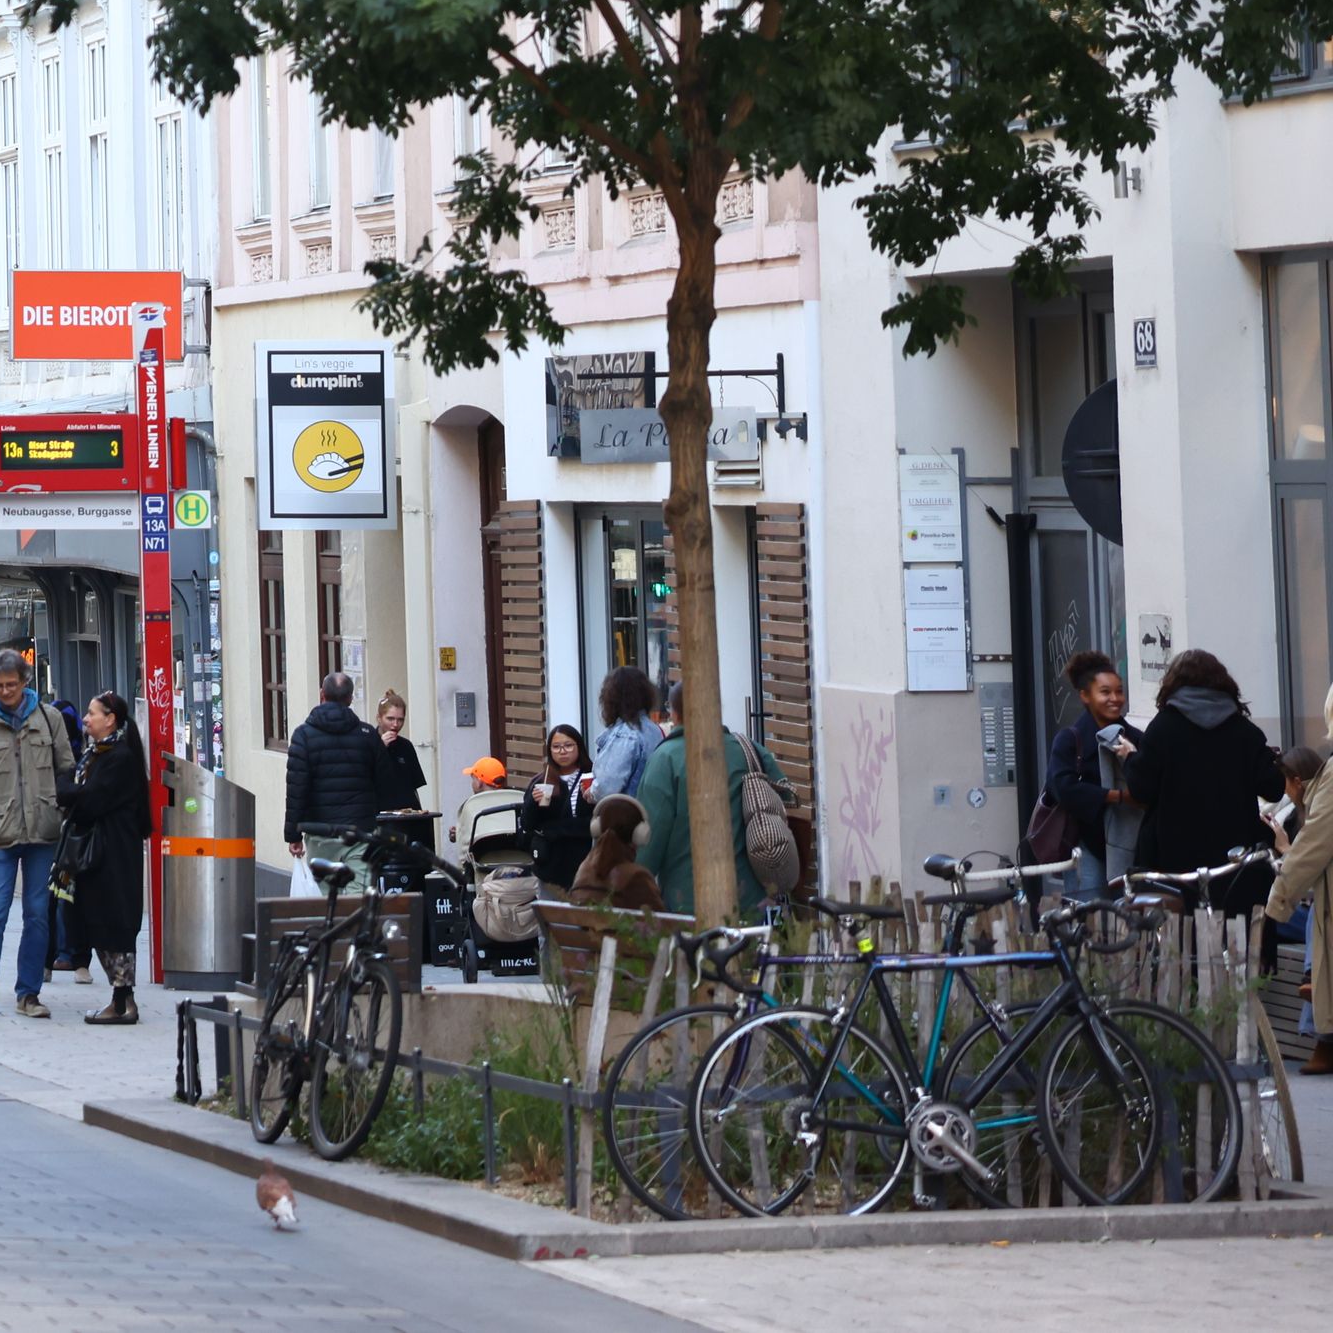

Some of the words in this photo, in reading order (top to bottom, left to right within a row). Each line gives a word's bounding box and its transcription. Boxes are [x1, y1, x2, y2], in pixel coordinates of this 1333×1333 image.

[23, 306, 53, 326] DIE
[59, 306, 167, 326] BIEROT
[1136, 321, 1154, 353] 68
[294, 359, 318, 369] Lin's
[321, 360, 354, 371] veggie
[146, 367, 160, 421] WIENER
[593, 423, 632, 449] La
[3, 441, 23, 459] 13A
[28, 441, 47, 450] Alser
[47, 440, 75, 451] Straße
[110, 440, 119, 457] 3
[147, 424, 159, 469] LINIEN
[2, 506, 75, 518] Neubaugasse,
[77, 506, 132, 518] Burggasse
[184, 499, 201, 520] H
[145, 519, 166, 532] 13A
[145, 537, 166, 550] N71
